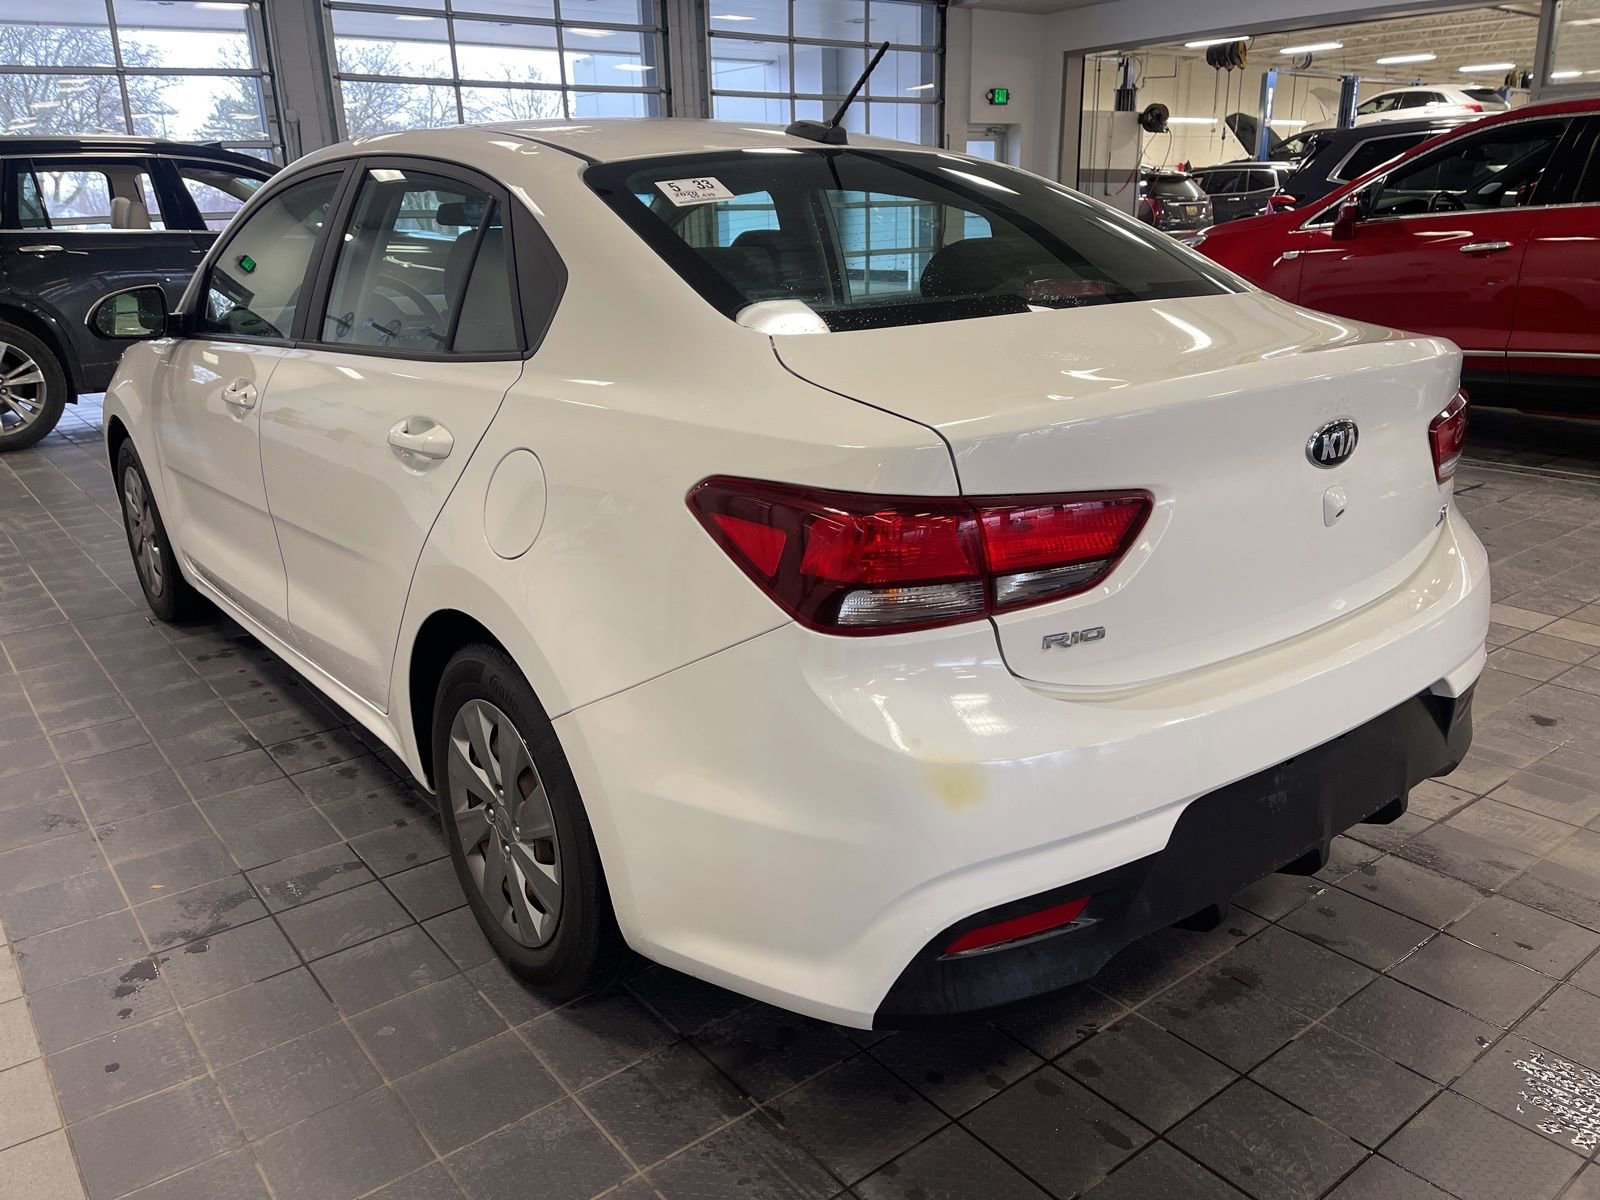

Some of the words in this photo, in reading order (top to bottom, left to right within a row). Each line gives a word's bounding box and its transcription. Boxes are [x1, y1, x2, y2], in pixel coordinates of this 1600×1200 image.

[667, 182, 681, 192] 5
[692, 180, 714, 190] 33
[1320, 426, 1356, 461] KIA
[1042, 626, 1105, 649] RIO
